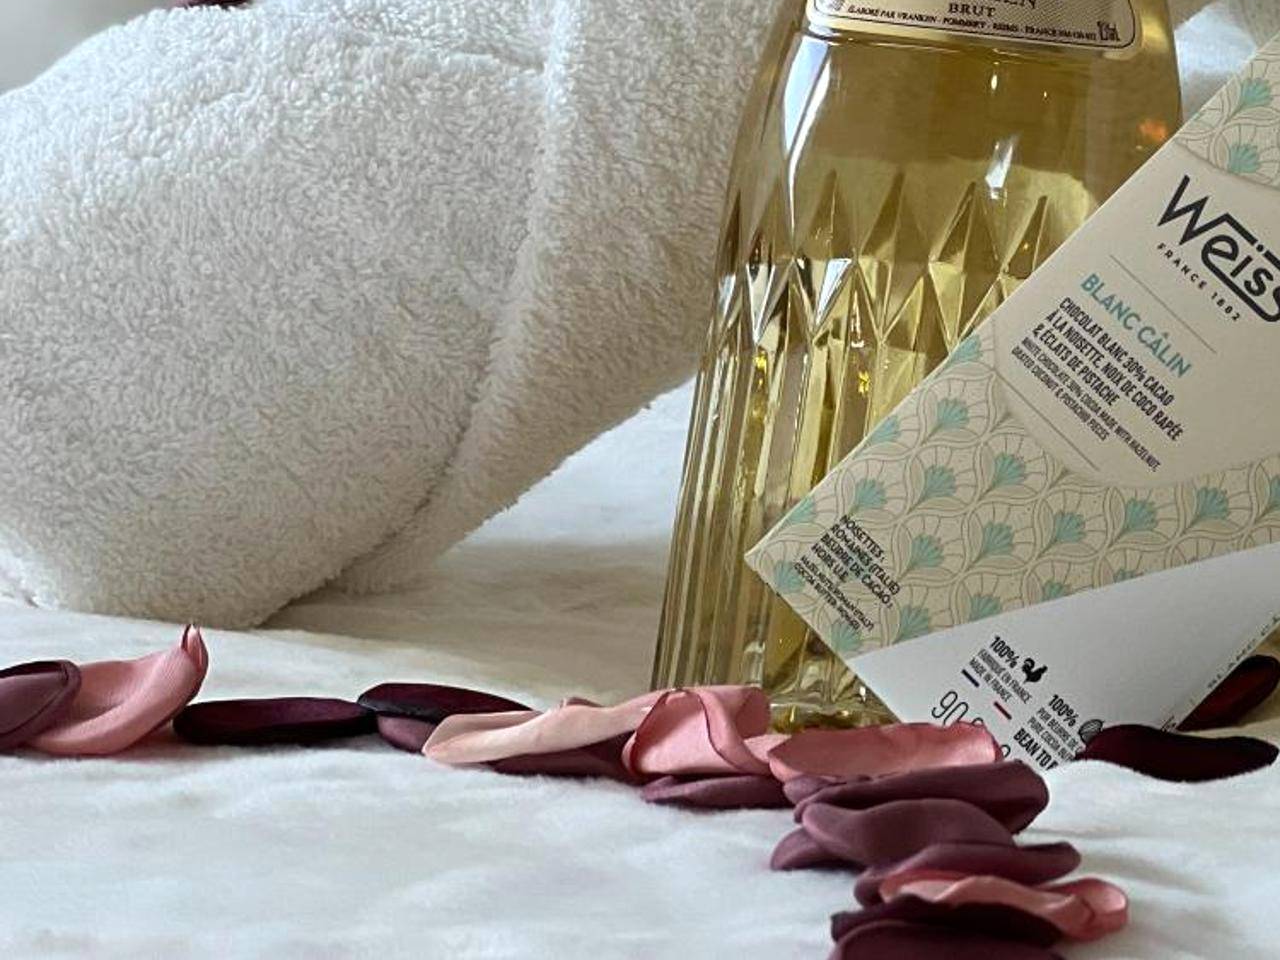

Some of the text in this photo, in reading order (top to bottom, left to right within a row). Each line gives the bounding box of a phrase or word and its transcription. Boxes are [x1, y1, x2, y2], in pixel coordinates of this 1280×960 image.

[948, 3, 997, 18] BRUT
[1156, 242, 1206, 289] FRANCE
[1080, 272, 1192, 378] BLANC CÂLIN
[1031, 324, 1119, 405] & ÉCLATS DE PISTACHE
[1052, 317, 1066, 332] LA
[1100, 362, 1125, 385] NOIX
[1120, 380, 1135, 395] DE
[1131, 390, 1156, 415] COCO
[1059, 297, 1174, 406] CHOCOLAT BLANC 30% CACAO
[1030, 365, 1056, 390] COCONUT
[1059, 393, 1090, 422] PISTACHIO
[1087, 419, 1108, 440] PIECES
[1037, 353, 1069, 383] CHOCOLATE
[1080, 393, 1101, 414] COCOA
[1098, 410, 1117, 429] MADE
[1114, 426, 1132, 443] WITH
[793, 563, 815, 584] COCOA
[811, 543, 835, 567] HORS
[821, 534, 852, 565] BEURRE
[850, 563, 863, 576] DE
[830, 524, 900, 594] ROMAINES (ITALIE)
[988, 636, 1020, 667] 100%
[968, 658, 985, 675] MADE
[989, 680, 1011, 701] FRANCE
[1001, 673, 1011, 683] EN
[1009, 681, 1031, 703] FRANCE
[1037, 708, 1049, 721] PUR
[1067, 739, 1077, 749] DE
[1047, 695, 1079, 726] 100%
[1014, 729, 1051, 767] BEAN TO
[1027, 718, 1043, 734] PURE
[1041, 731, 1060, 751] COCOA
